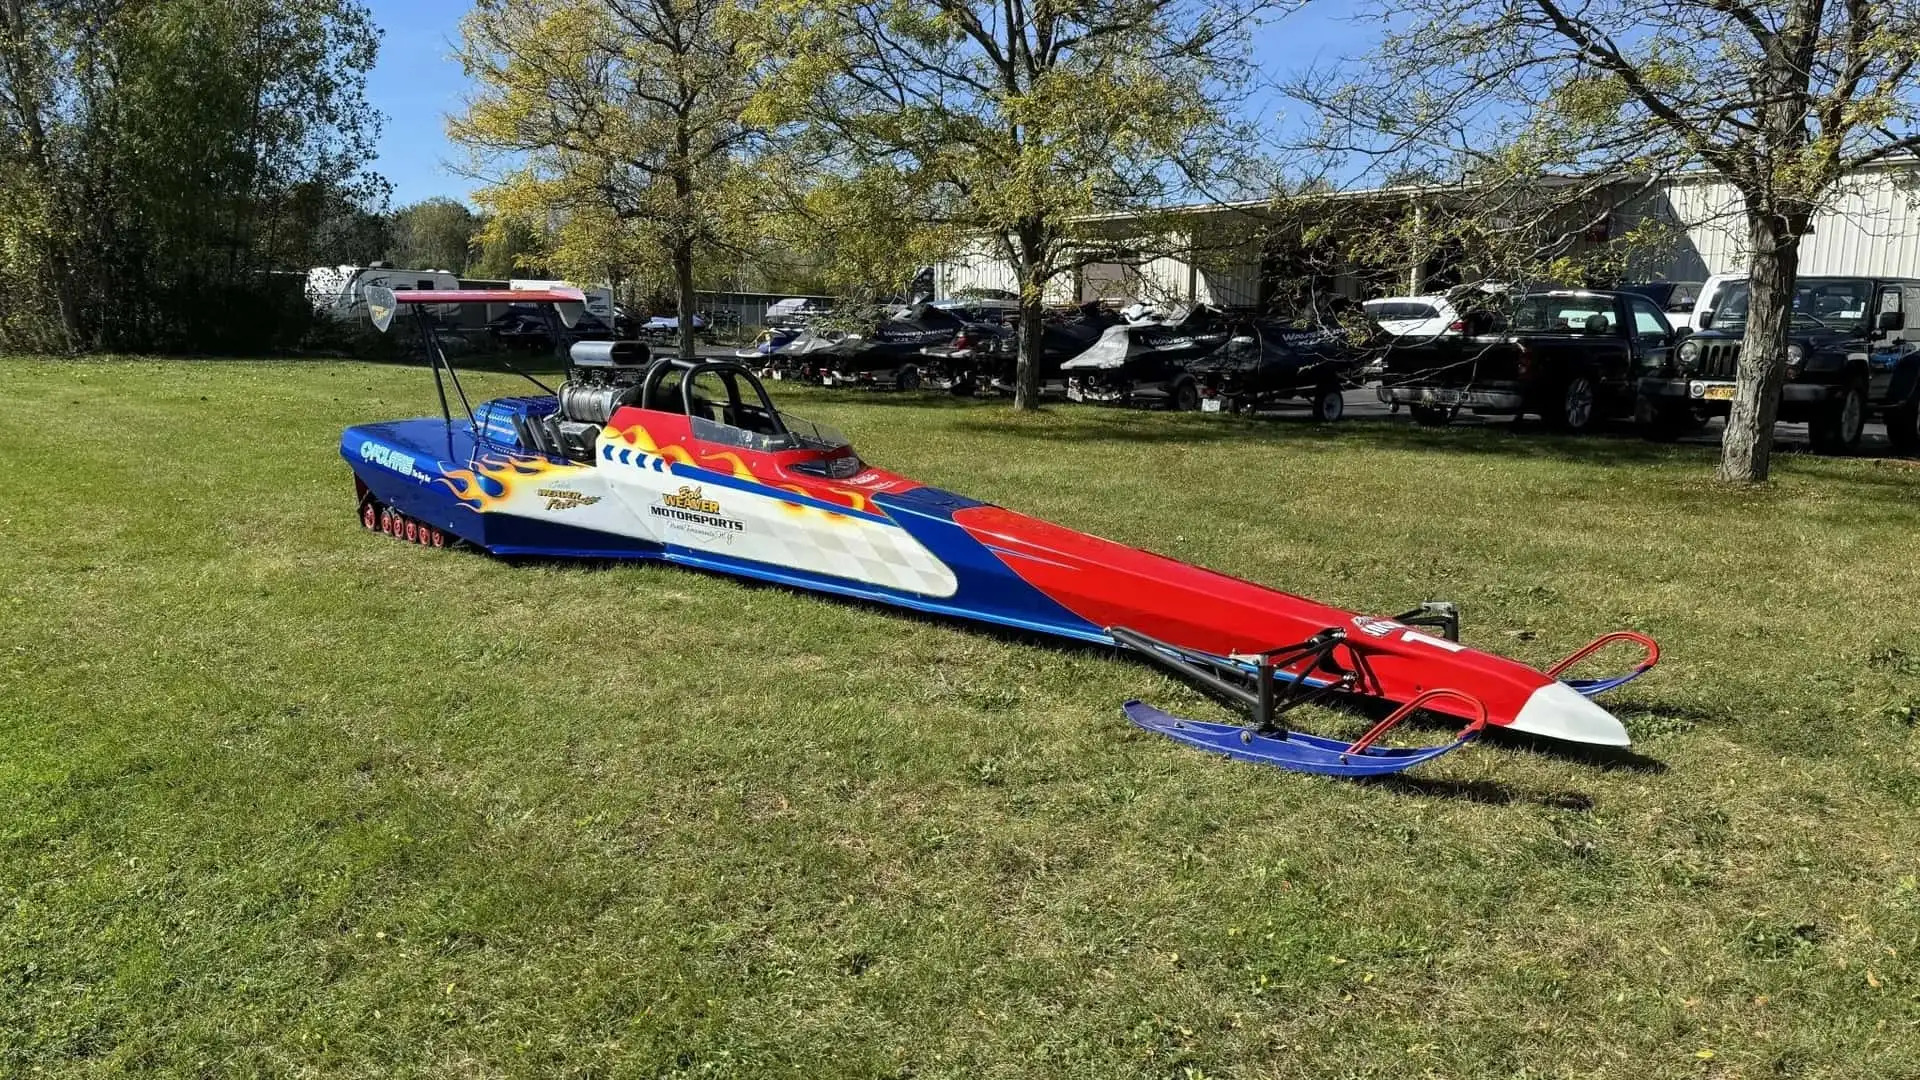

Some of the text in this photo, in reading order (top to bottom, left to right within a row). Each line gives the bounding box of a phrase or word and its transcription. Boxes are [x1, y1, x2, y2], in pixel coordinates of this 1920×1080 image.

[678, 485, 702, 500] Bob
[662, 493, 720, 514] WEAVER
[650, 506, 744, 531] MOTORSPORTS
[1400, 630, 1468, 652] 1
